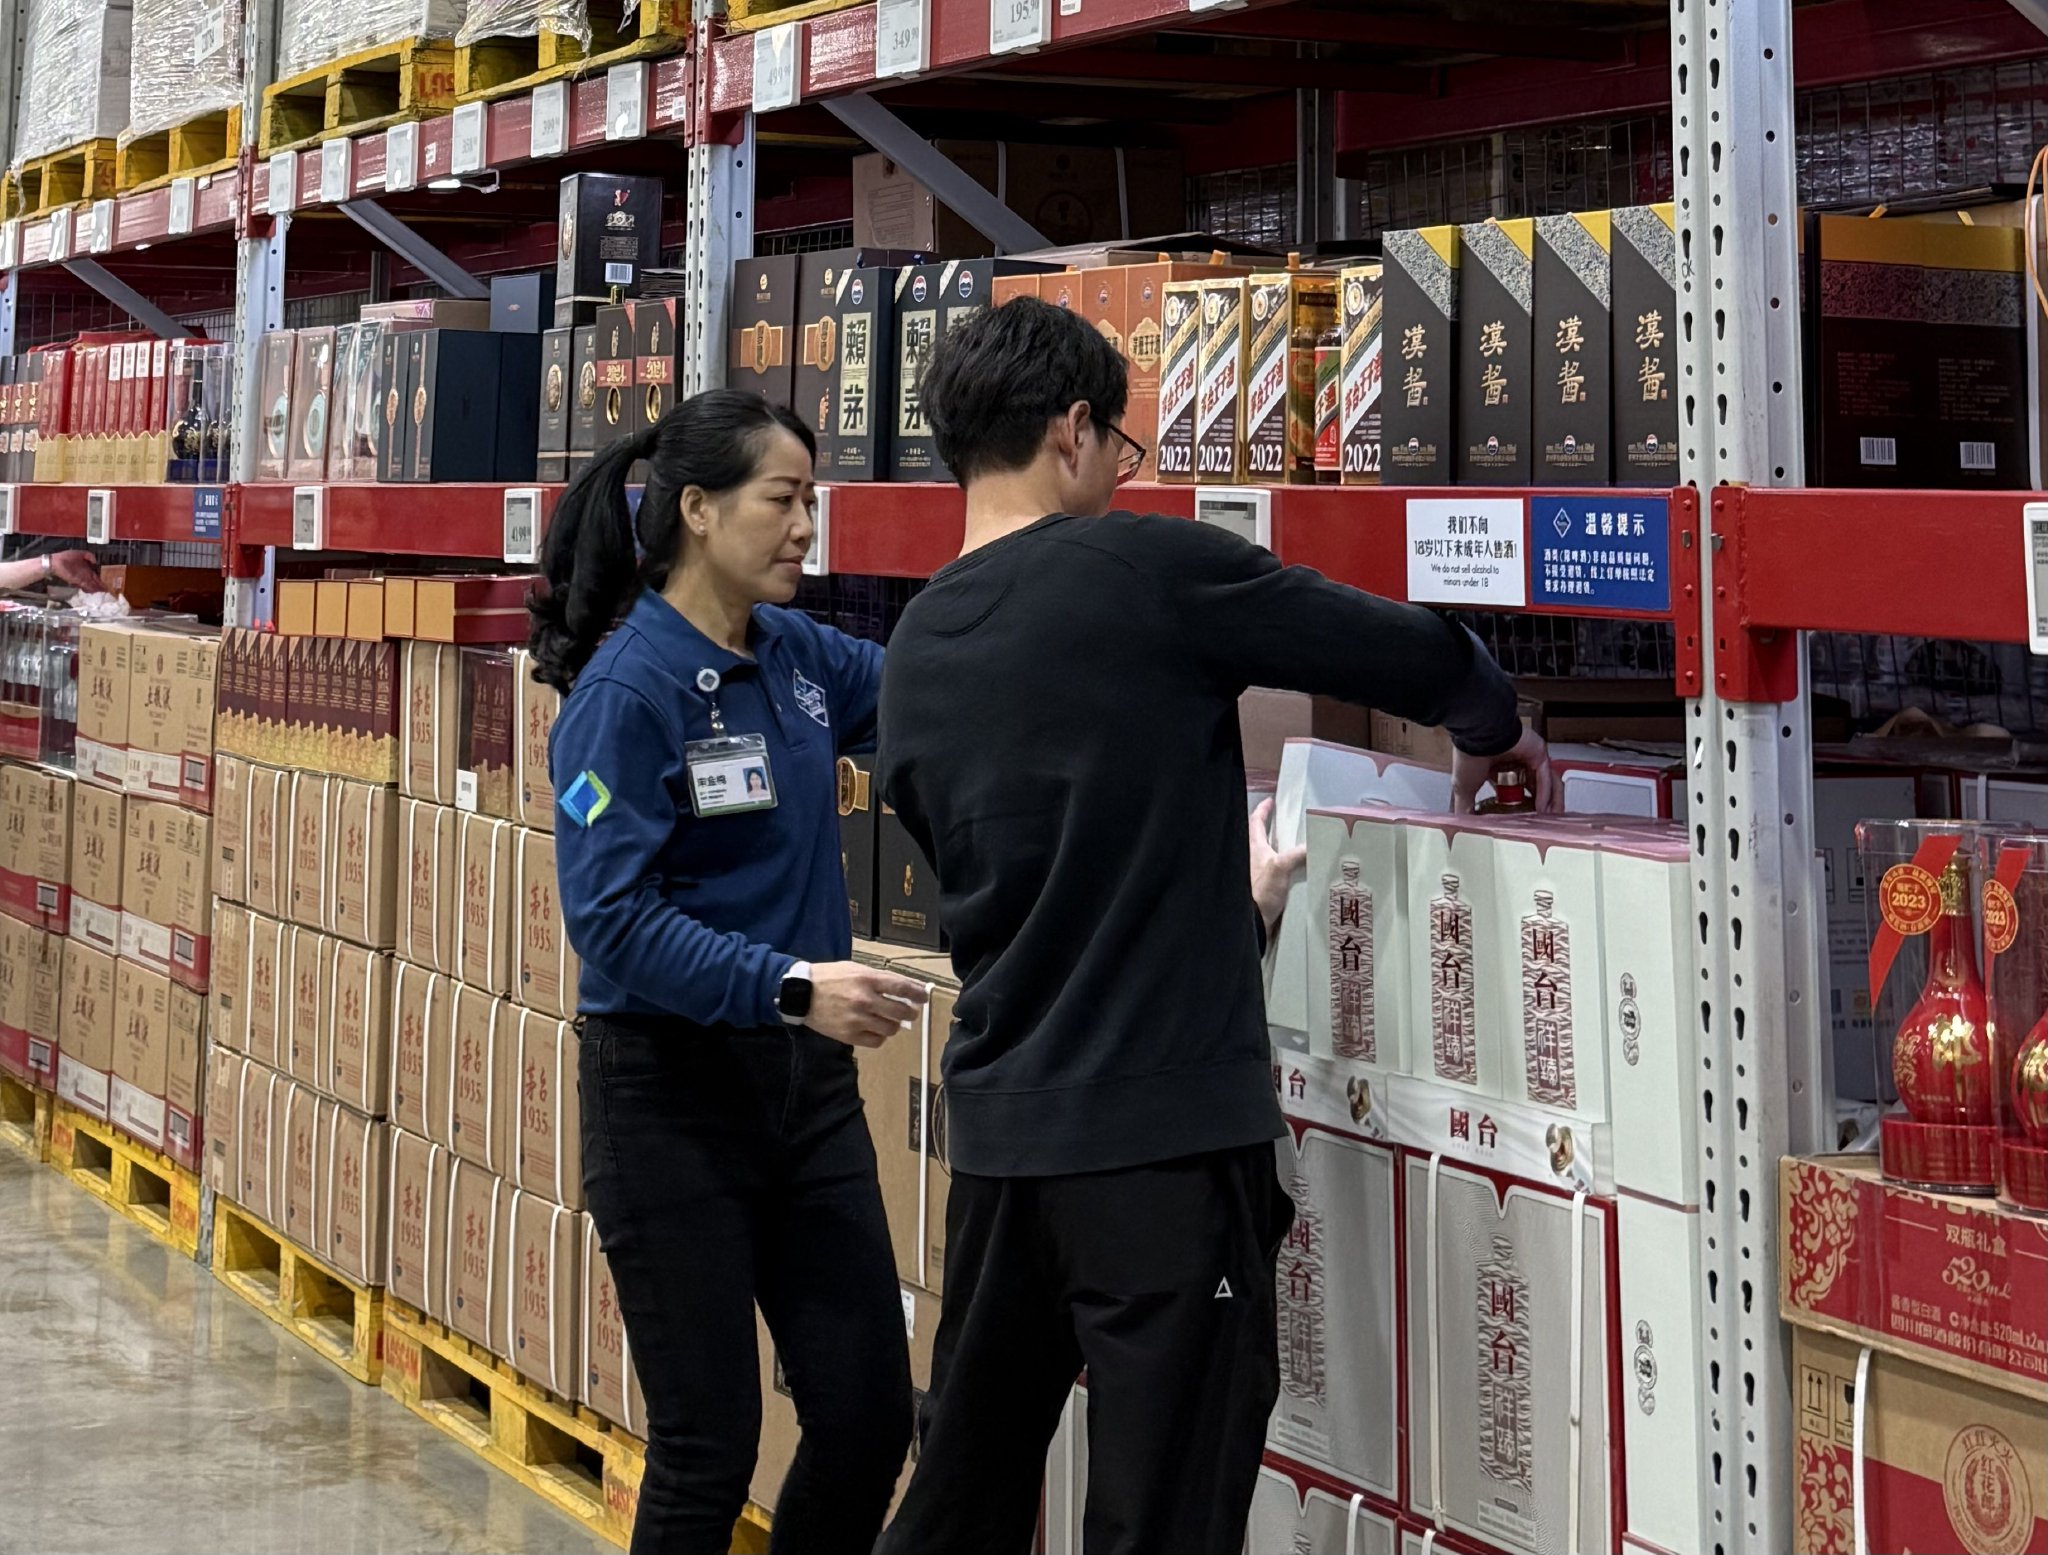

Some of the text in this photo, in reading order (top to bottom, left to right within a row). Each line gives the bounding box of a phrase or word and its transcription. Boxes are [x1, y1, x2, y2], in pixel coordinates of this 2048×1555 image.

[1159, 445, 1191, 472] 2022
[1198, 445, 1233, 472] 2022
[1249, 445, 1283, 472] 2022
[1344, 444, 1381, 472] 2022
[1447, 515, 1488, 534] 我们不向
[1585, 512, 1645, 537] 温馨提示
[1431, 564, 1500, 574] We do not sell alcohol to
[1463, 578, 1479, 587] under
[1481, 578, 1489, 587] 18
[528, 743, 546, 768] 193
[530, 879, 550, 921] 茅台
[1892, 892, 1926, 909] 2023
[528, 924, 551, 950] 1935
[459, 1076, 482, 1104] 1935
[525, 1056, 547, 1102] 茅台
[522, 1106, 548, 1135] 1935
[1450, 1106, 1498, 1149] 國台
[400, 1219, 422, 1250] 1935
[465, 1204, 485, 1250] 茅台
[1945, 1222, 2007, 1258] 双瓶礼盒
[462, 1250, 485, 1282] 1935
[525, 1239, 546, 1287] 茅台
[523, 1287, 546, 1321] 1935
[1491, 1281, 1517, 1375] 國台
